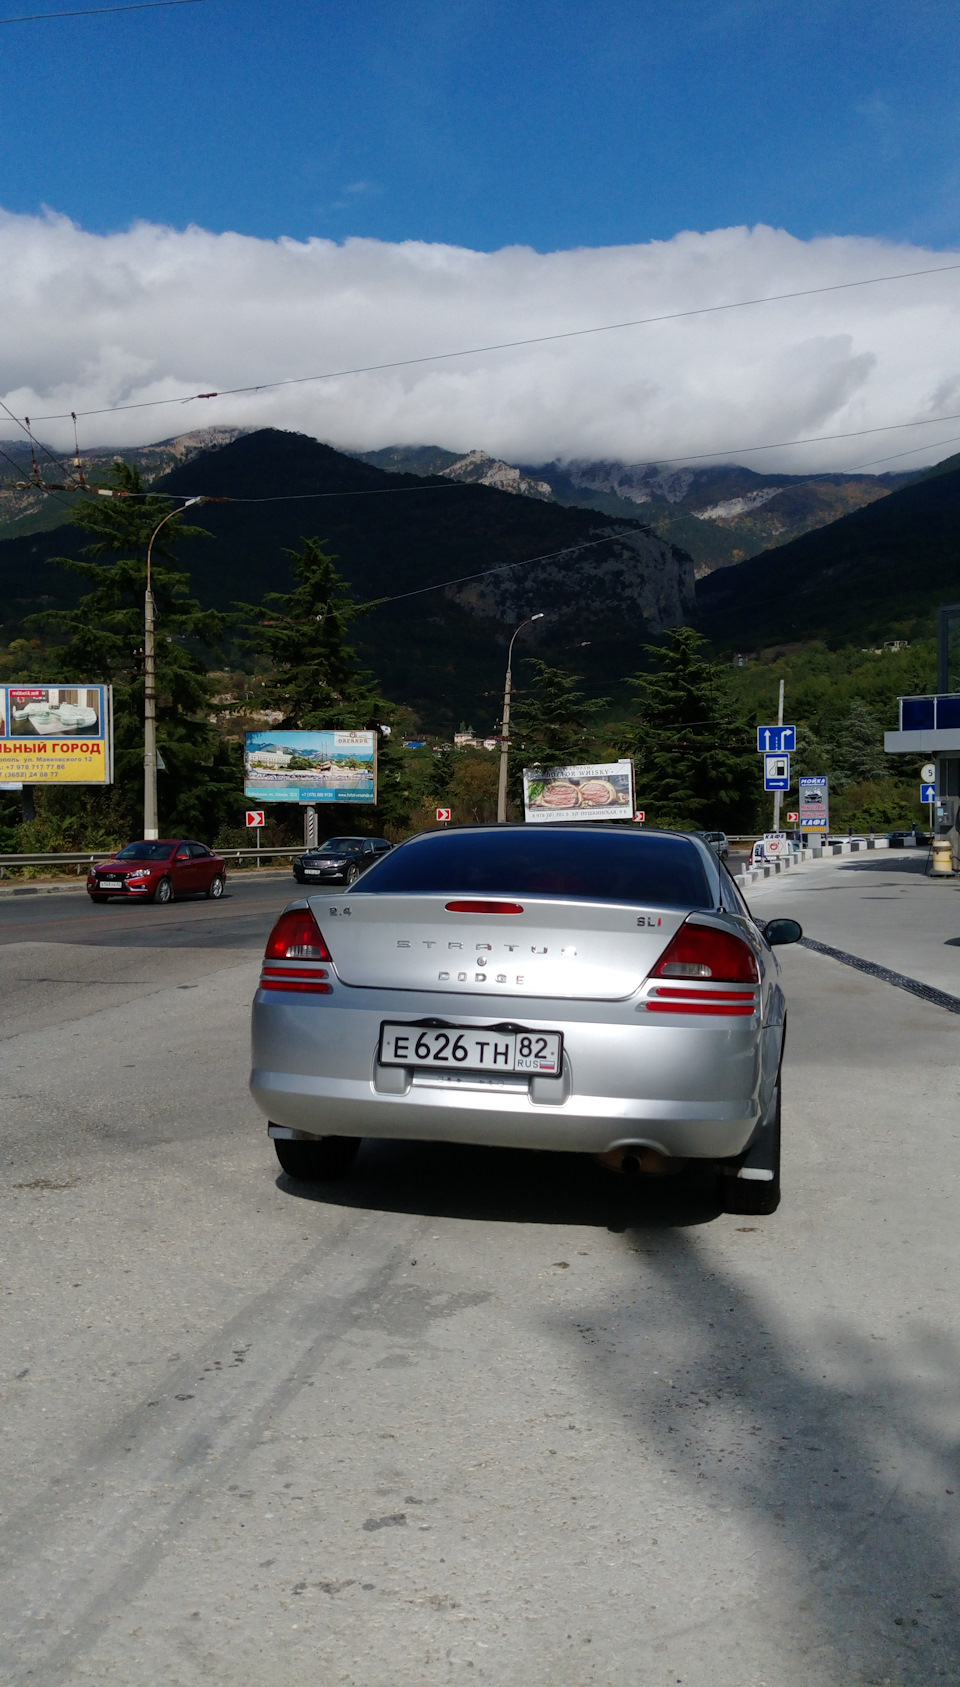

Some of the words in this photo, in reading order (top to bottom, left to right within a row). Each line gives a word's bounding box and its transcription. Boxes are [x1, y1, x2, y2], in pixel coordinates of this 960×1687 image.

[52, 743, 101, 755] ГОРОД
[927, 769, 933, 777] 5
[801, 818, 826, 826] КАФЕ
[329, 906, 352, 917] 2.4
[396, 940, 579, 957] STRATUS
[437, 971, 526, 986] DODGE
[519, 1036, 548, 1060] 82
[517, 1058, 539, 1069] RUS
